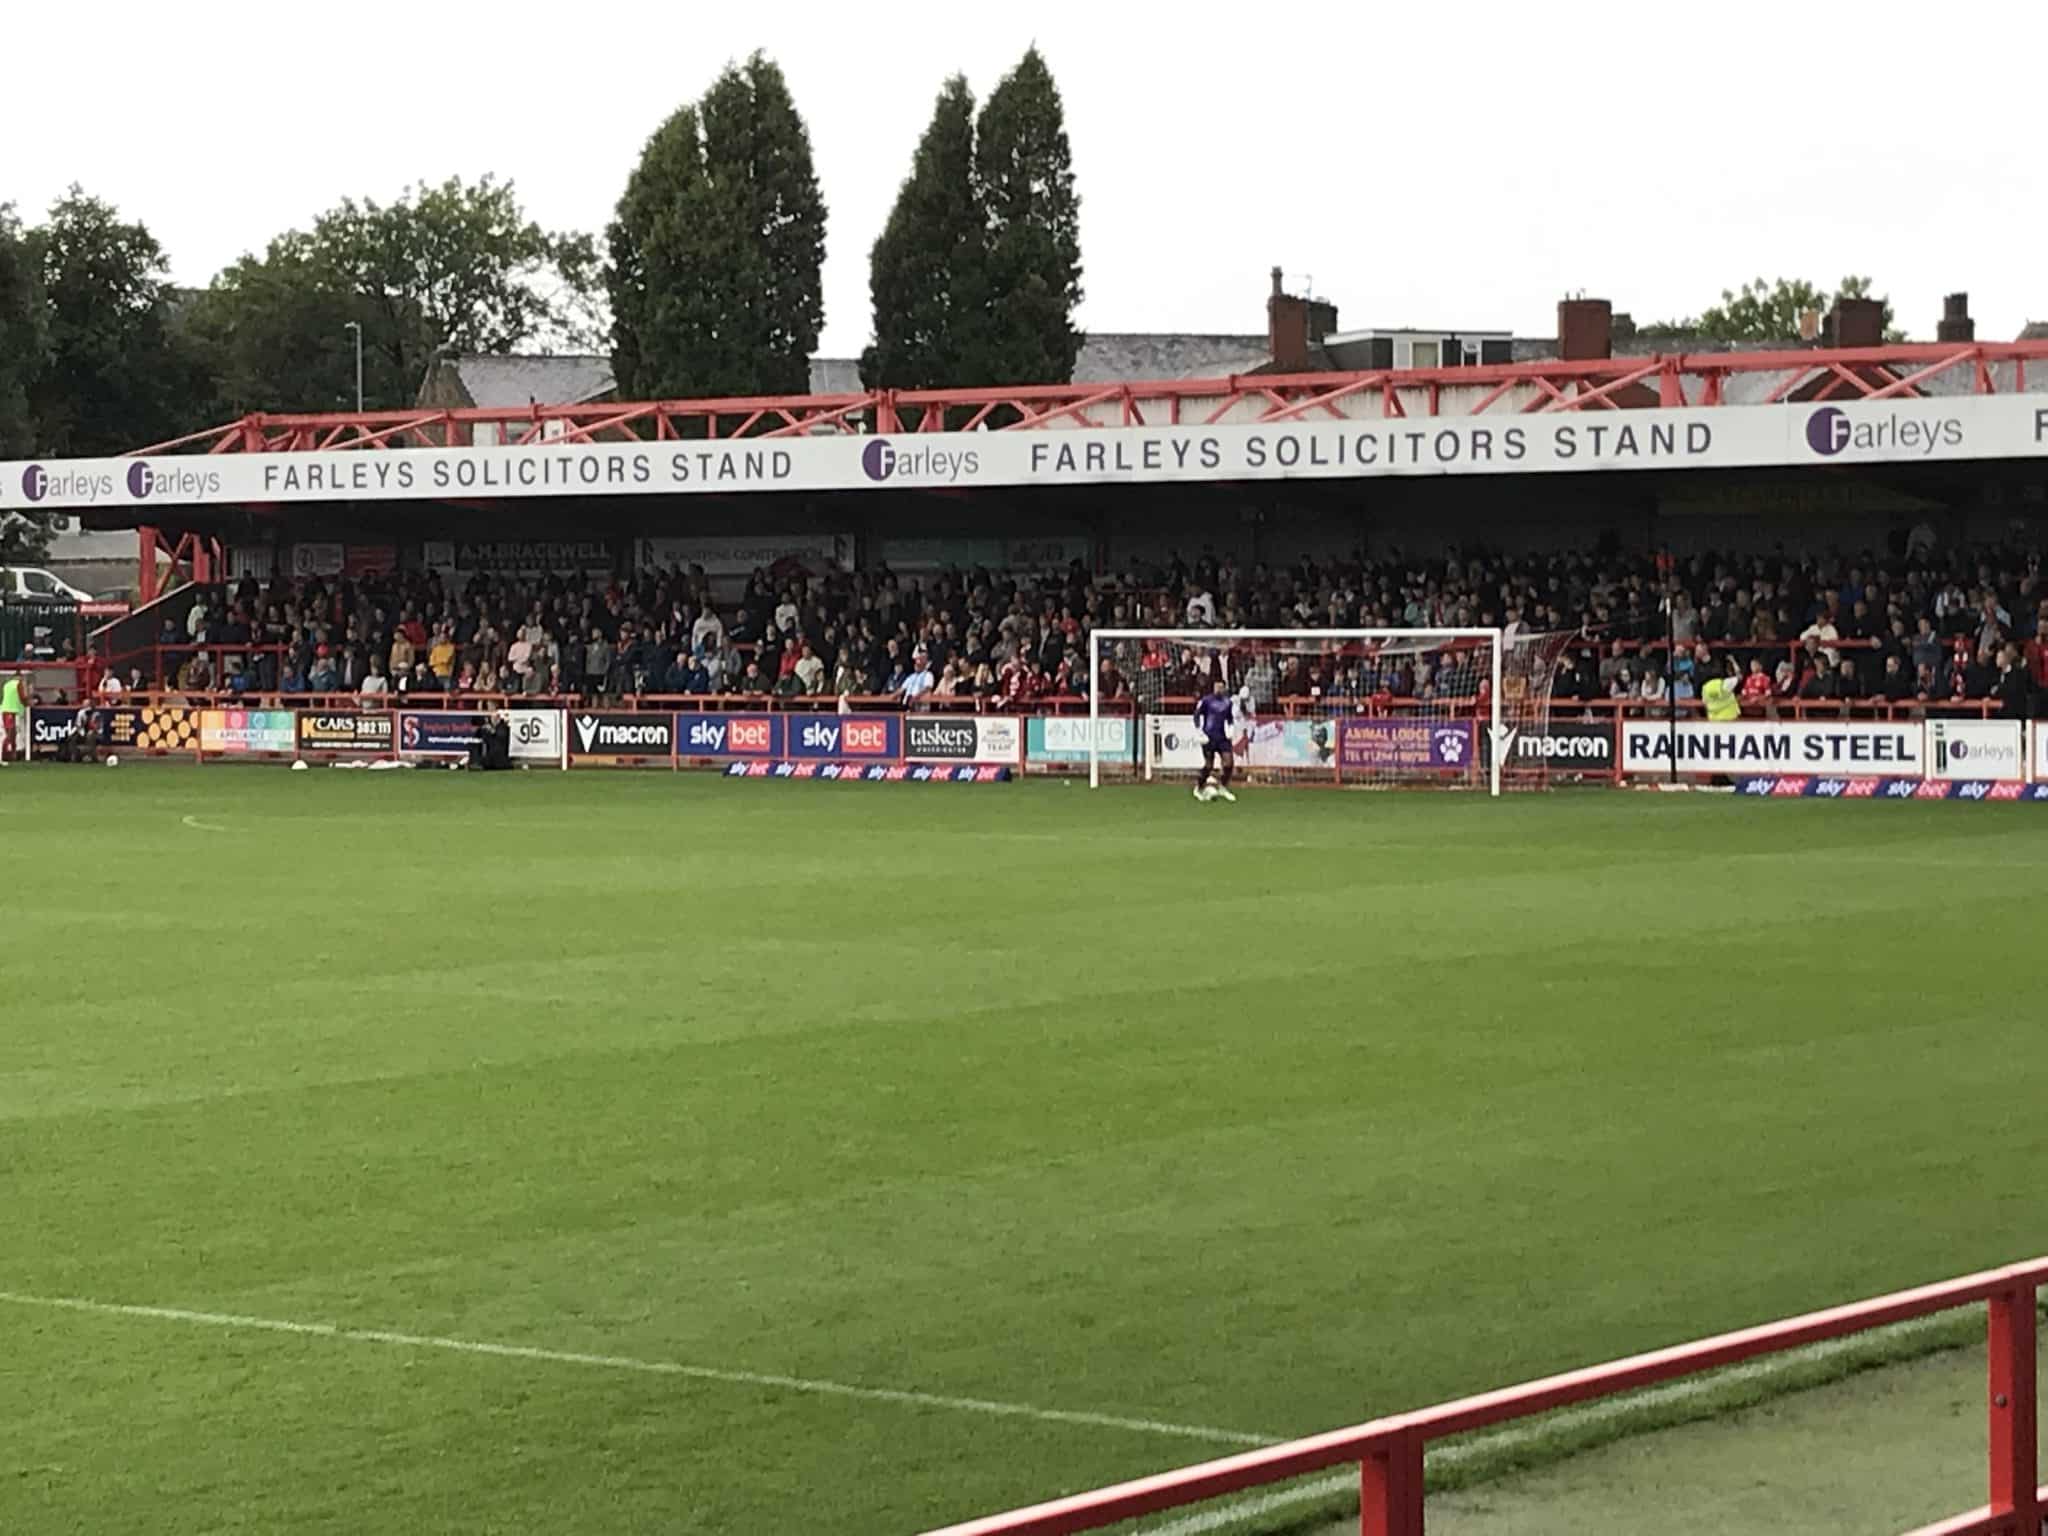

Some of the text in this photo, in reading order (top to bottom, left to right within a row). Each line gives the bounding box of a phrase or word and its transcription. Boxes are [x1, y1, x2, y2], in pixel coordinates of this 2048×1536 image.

[1830, 413, 1963, 455] Farleys
[1032, 422, 1711, 472] FARLEYS SOLICITORS STAND
[265, 451, 791, 490] FARLEYS SOLICITORS STAND
[880, 444, 979, 482] Farleys
[36, 470, 112, 502] Farleys
[142, 466, 220, 499] Farleys
[600, 725, 668, 745] macron
[690, 720, 766, 750] sky bet
[803, 721, 883, 752] sky bet
[910, 722, 973, 747] taskers
[1393, 728, 1431, 741] LODGE
[1518, 735, 1608, 758] macron
[1630, 734, 1916, 761] RAINHAM STEEL
[729, 762, 769, 776] sky bet
[775, 762, 816, 776] sky bet
[822, 763, 863, 778] sky bet
[868, 764, 907, 779] sky bet
[912, 765, 952, 780] sky bet
[957, 765, 997, 781] sky bet
[1746, 777, 1806, 794] sky bet
[1815, 779, 1878, 796] sky bet
[1887, 781, 1949, 797] sky bet
[1959, 782, 1991, 799] sky
[1990, 782, 2023, 798] bet
